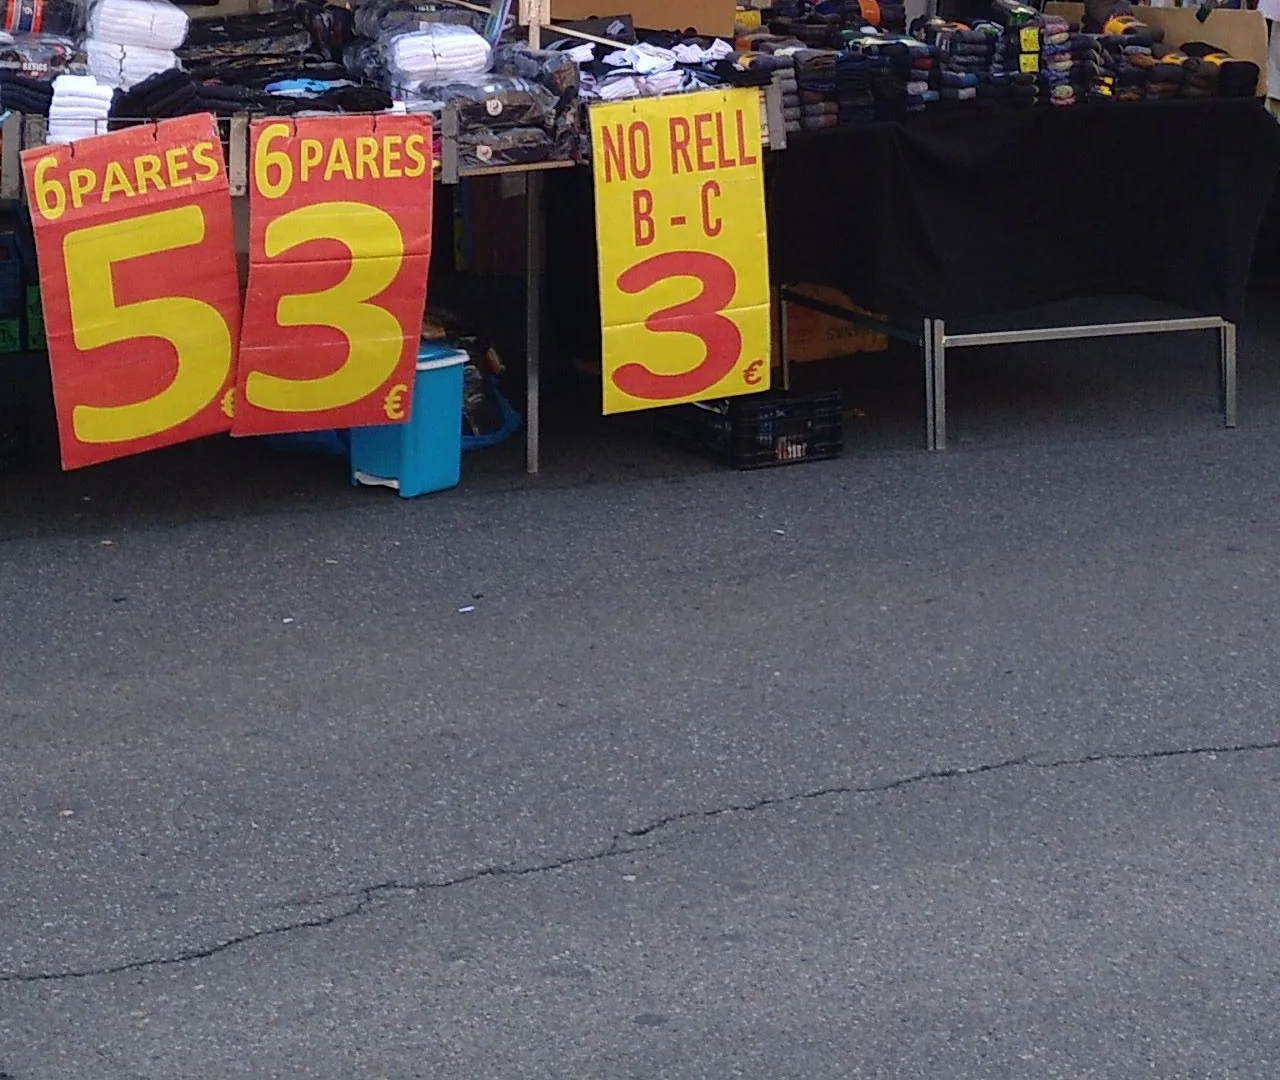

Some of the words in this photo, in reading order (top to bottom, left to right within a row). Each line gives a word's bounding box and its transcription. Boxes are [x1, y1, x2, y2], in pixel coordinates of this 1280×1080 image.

[33, 156, 67, 222] 6
[69, 140, 221, 208] PARES
[254, 122, 295, 200] 6
[298, 133, 427, 182] PARES
[600, 119, 654, 183] NO
[667, 108, 757, 174] RELL
[61, 204, 234, 444] 5
[244, 201, 405, 413] 3
[609, 249, 744, 401] 3
